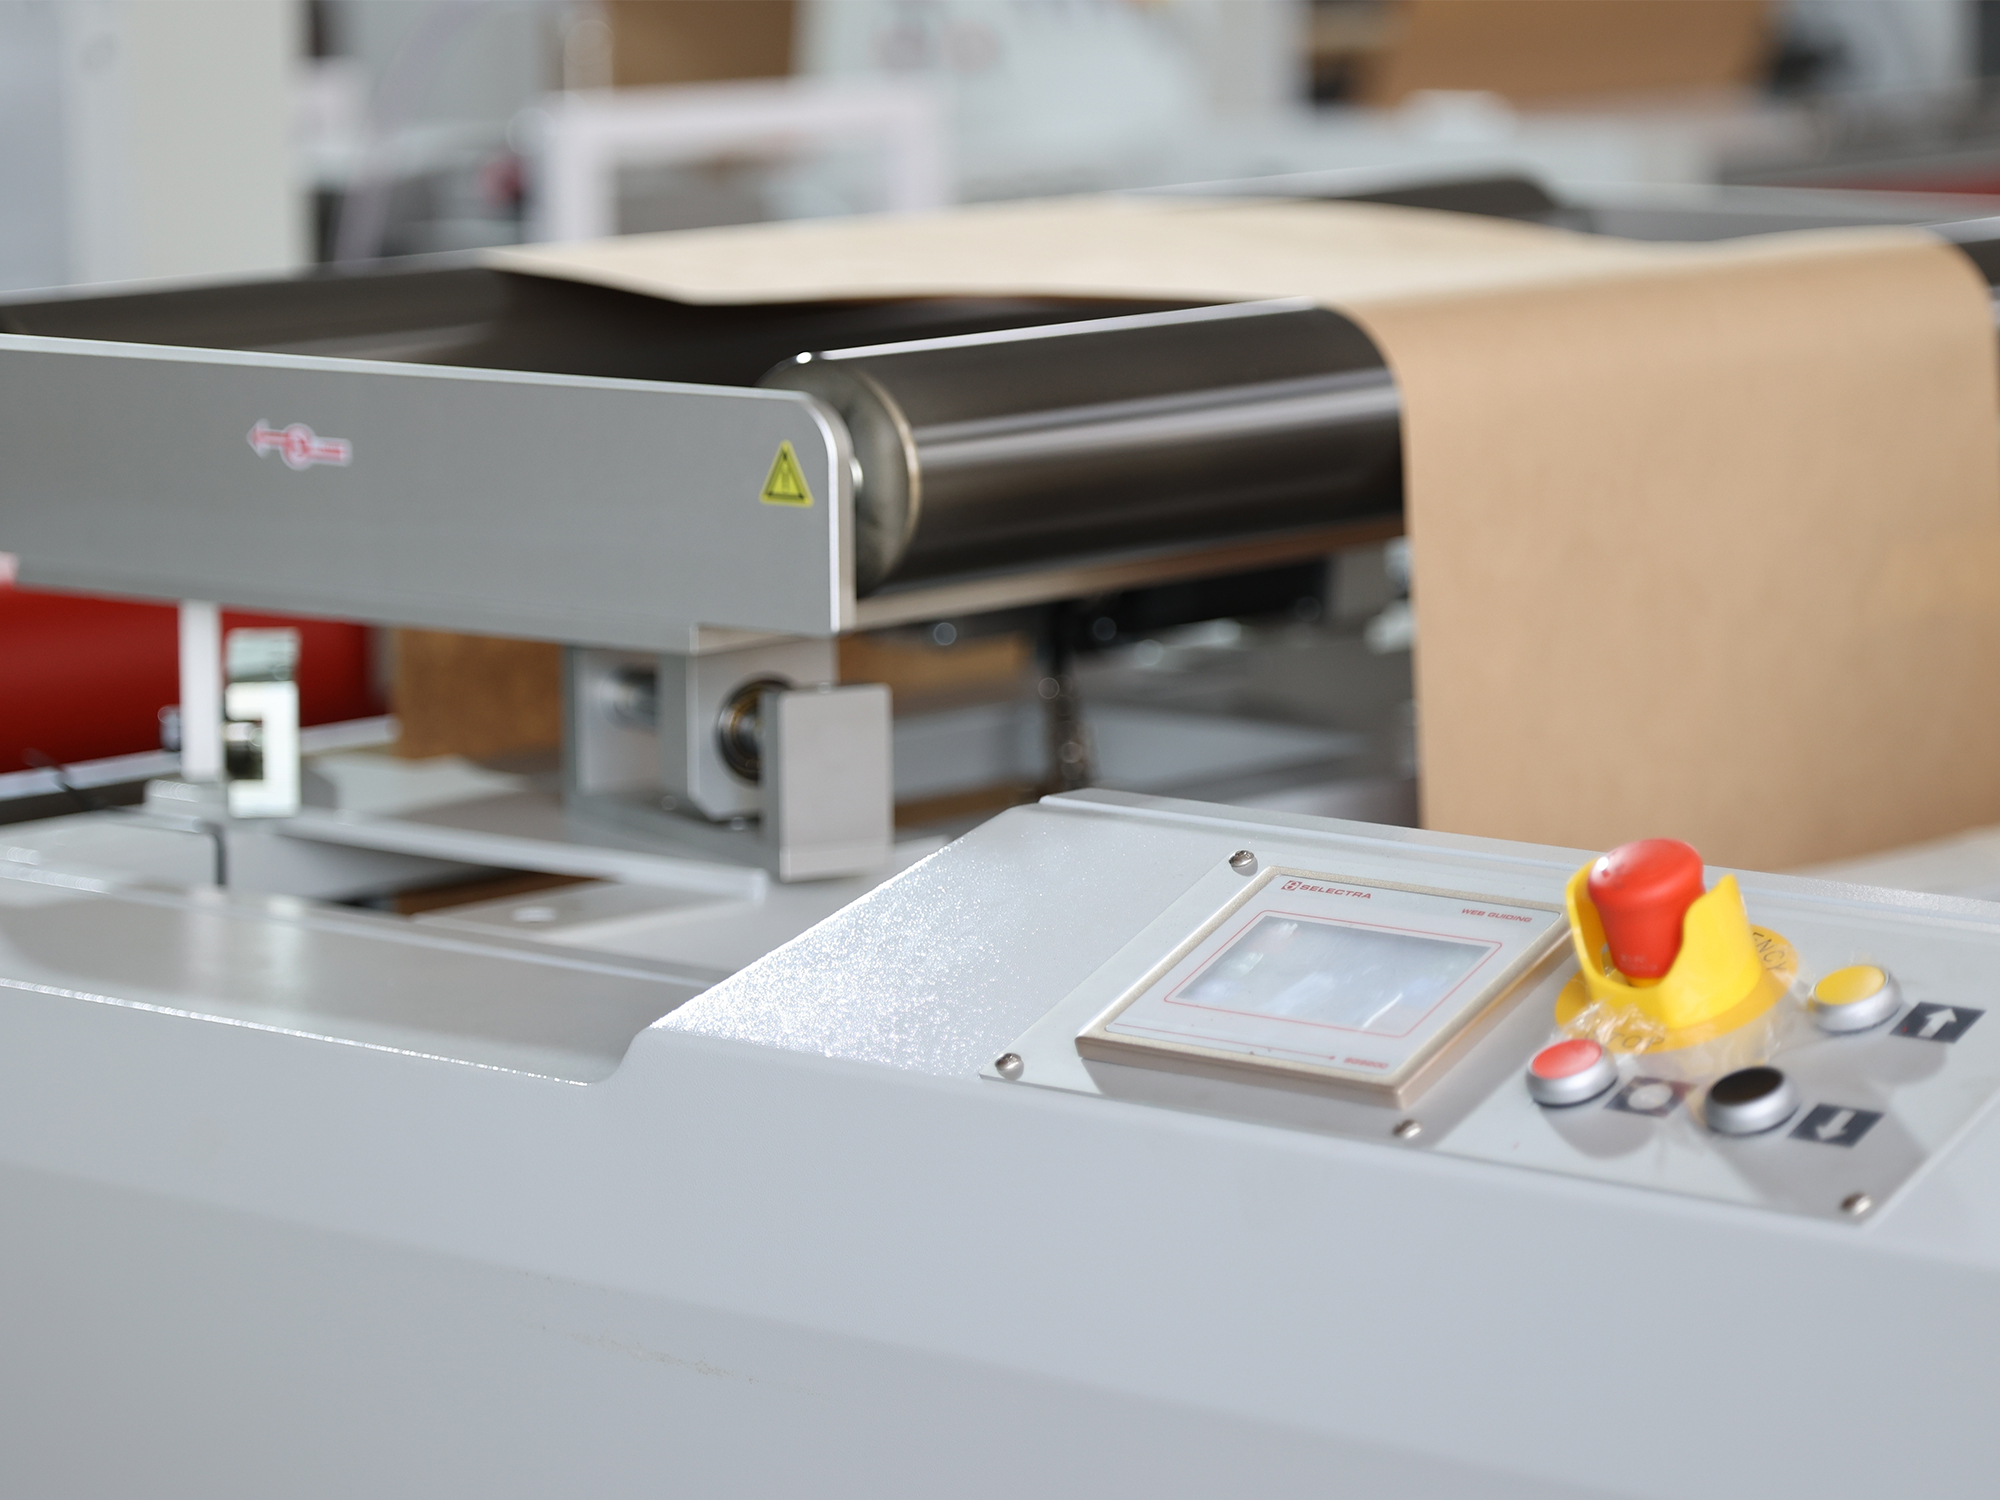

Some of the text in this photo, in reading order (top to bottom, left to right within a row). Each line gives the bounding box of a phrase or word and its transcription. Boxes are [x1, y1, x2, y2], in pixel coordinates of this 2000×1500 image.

[1299, 884, 1372, 899] SELECTRA
[1461, 908, 1533, 923] WEB GUIDING
